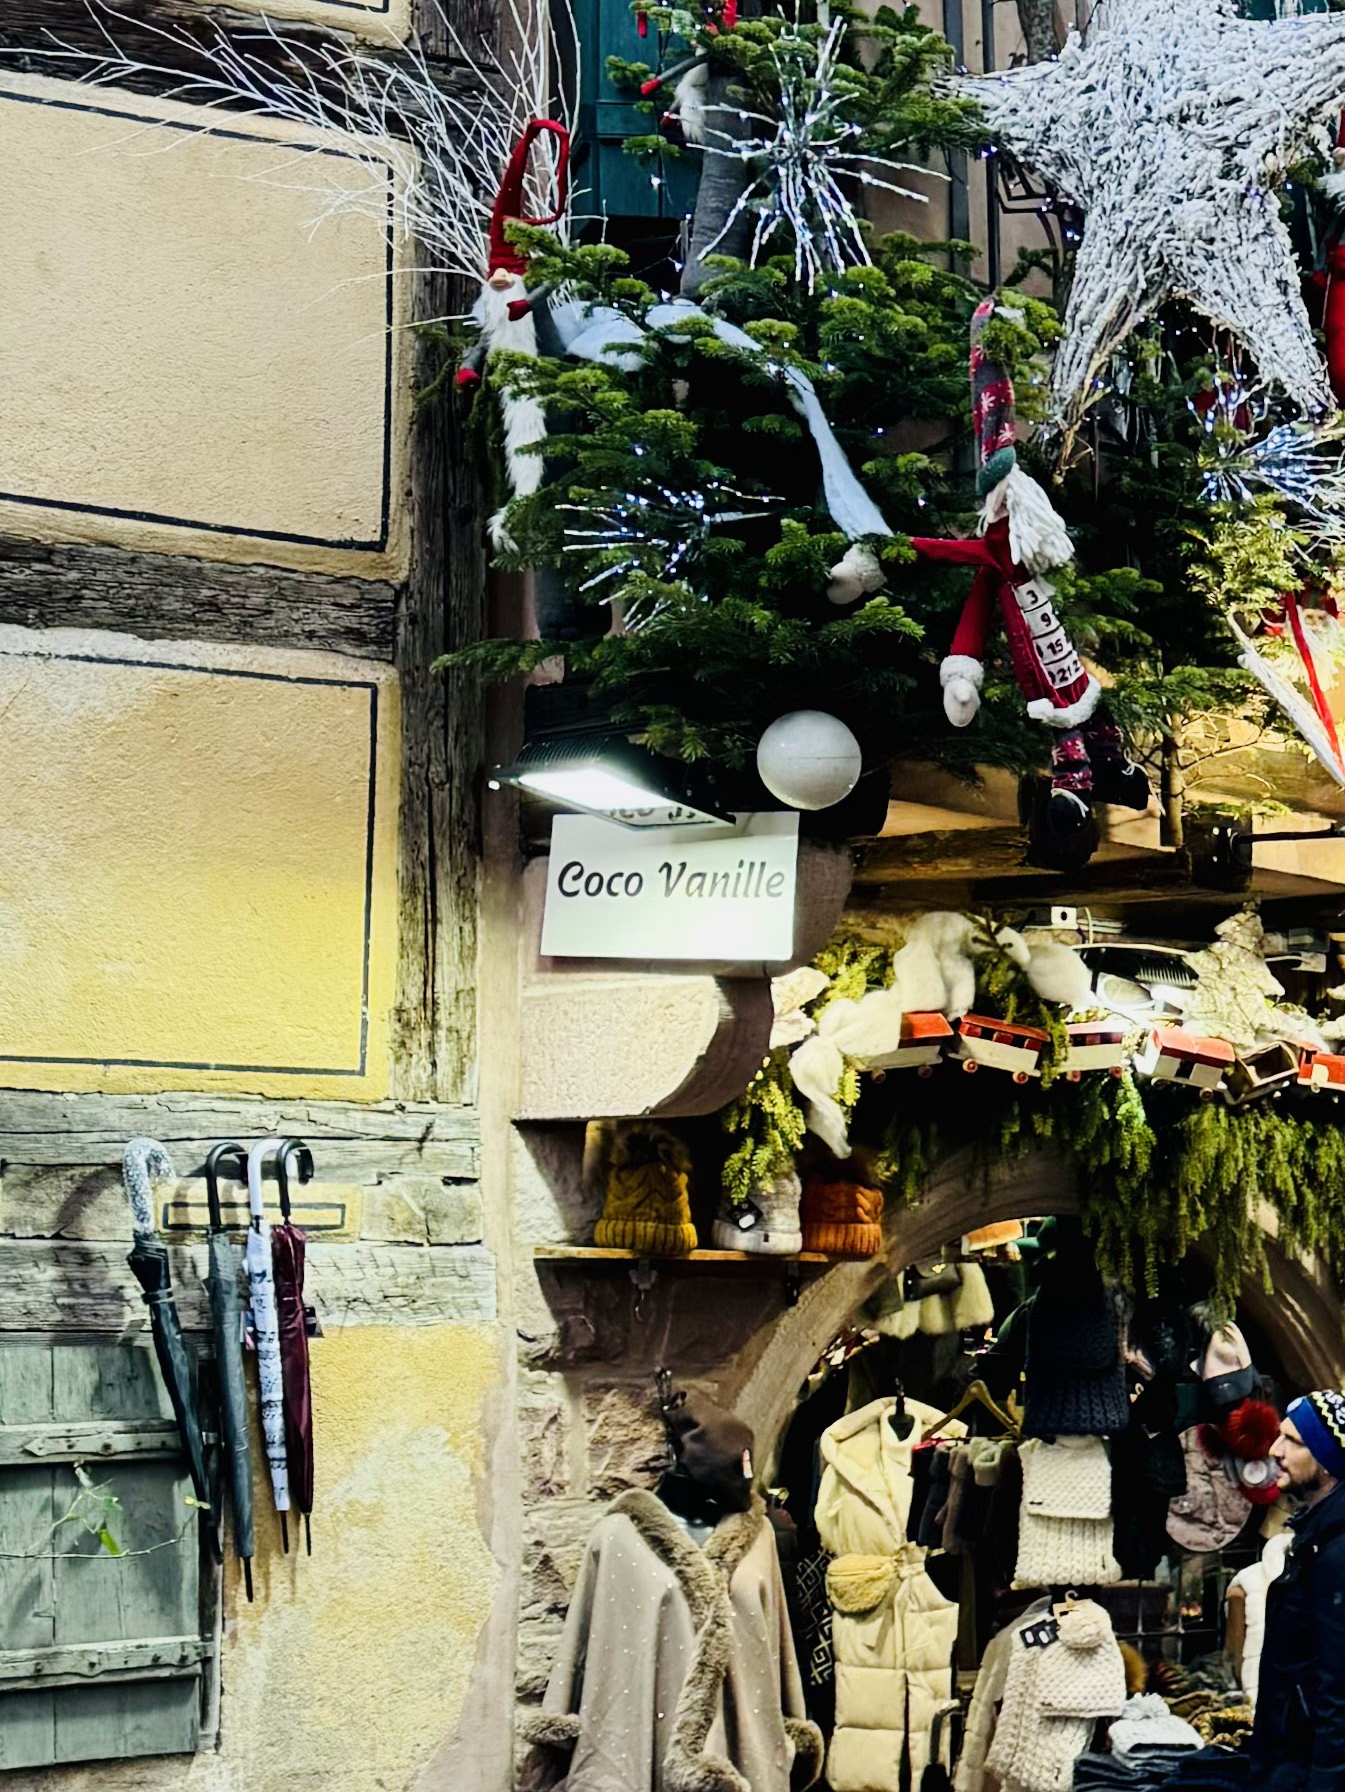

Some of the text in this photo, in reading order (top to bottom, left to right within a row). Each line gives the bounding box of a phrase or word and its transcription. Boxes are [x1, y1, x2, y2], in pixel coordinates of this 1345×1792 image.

[1027, 589, 1039, 605] 3
[1040, 612, 1052, 628] 9
[1046, 638, 1064, 656] 15
[557, 858, 786, 899] Coco Vanille
